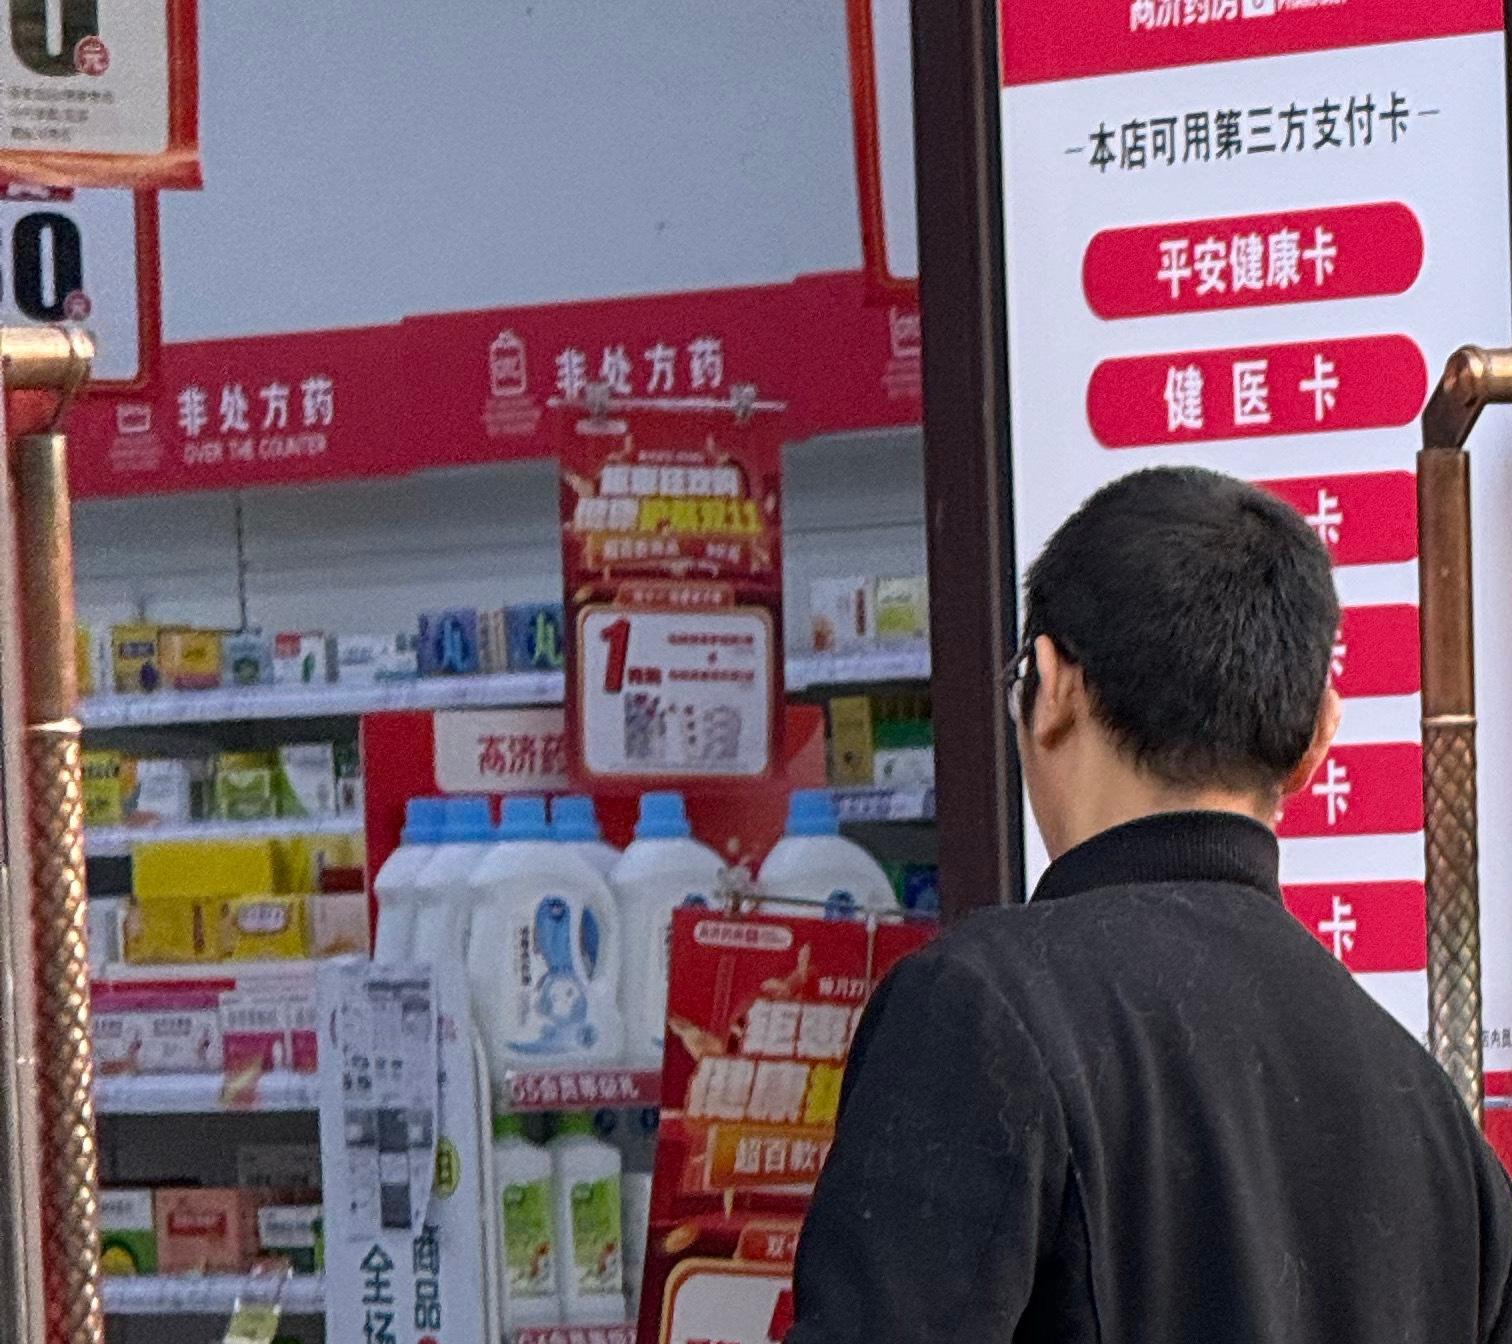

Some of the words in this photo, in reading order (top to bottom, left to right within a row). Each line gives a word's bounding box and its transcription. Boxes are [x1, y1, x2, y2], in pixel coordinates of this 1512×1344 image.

[1088, 91, 1409, 173] 本店可用第三方支付卡
[1156, 226, 1338, 298] 平安健康卡
[177, 375, 335, 437] 非处方药
[1164, 353, 1340, 431] 健医卡
[1312, 758, 1352, 826] 卡
[1318, 895, 1358, 962] 卡
